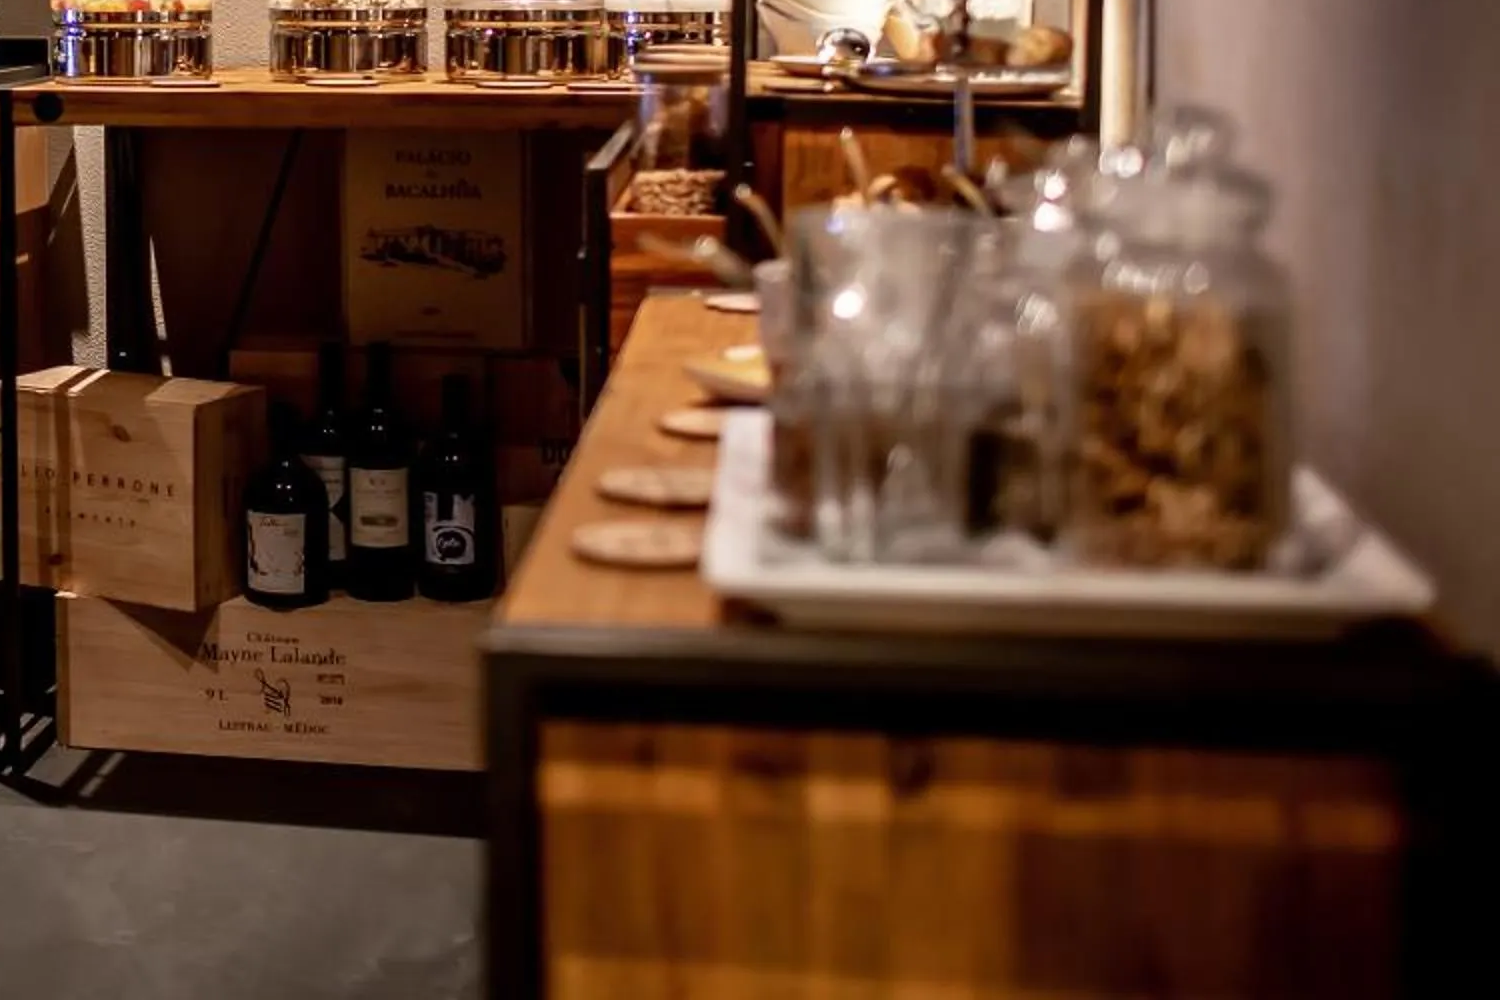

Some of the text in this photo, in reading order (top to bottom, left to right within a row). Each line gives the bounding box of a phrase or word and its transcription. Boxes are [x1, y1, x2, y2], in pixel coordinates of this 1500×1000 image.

[73, 471, 176, 498] PERRONE
[202, 643, 347, 666] Mayne Lalande
